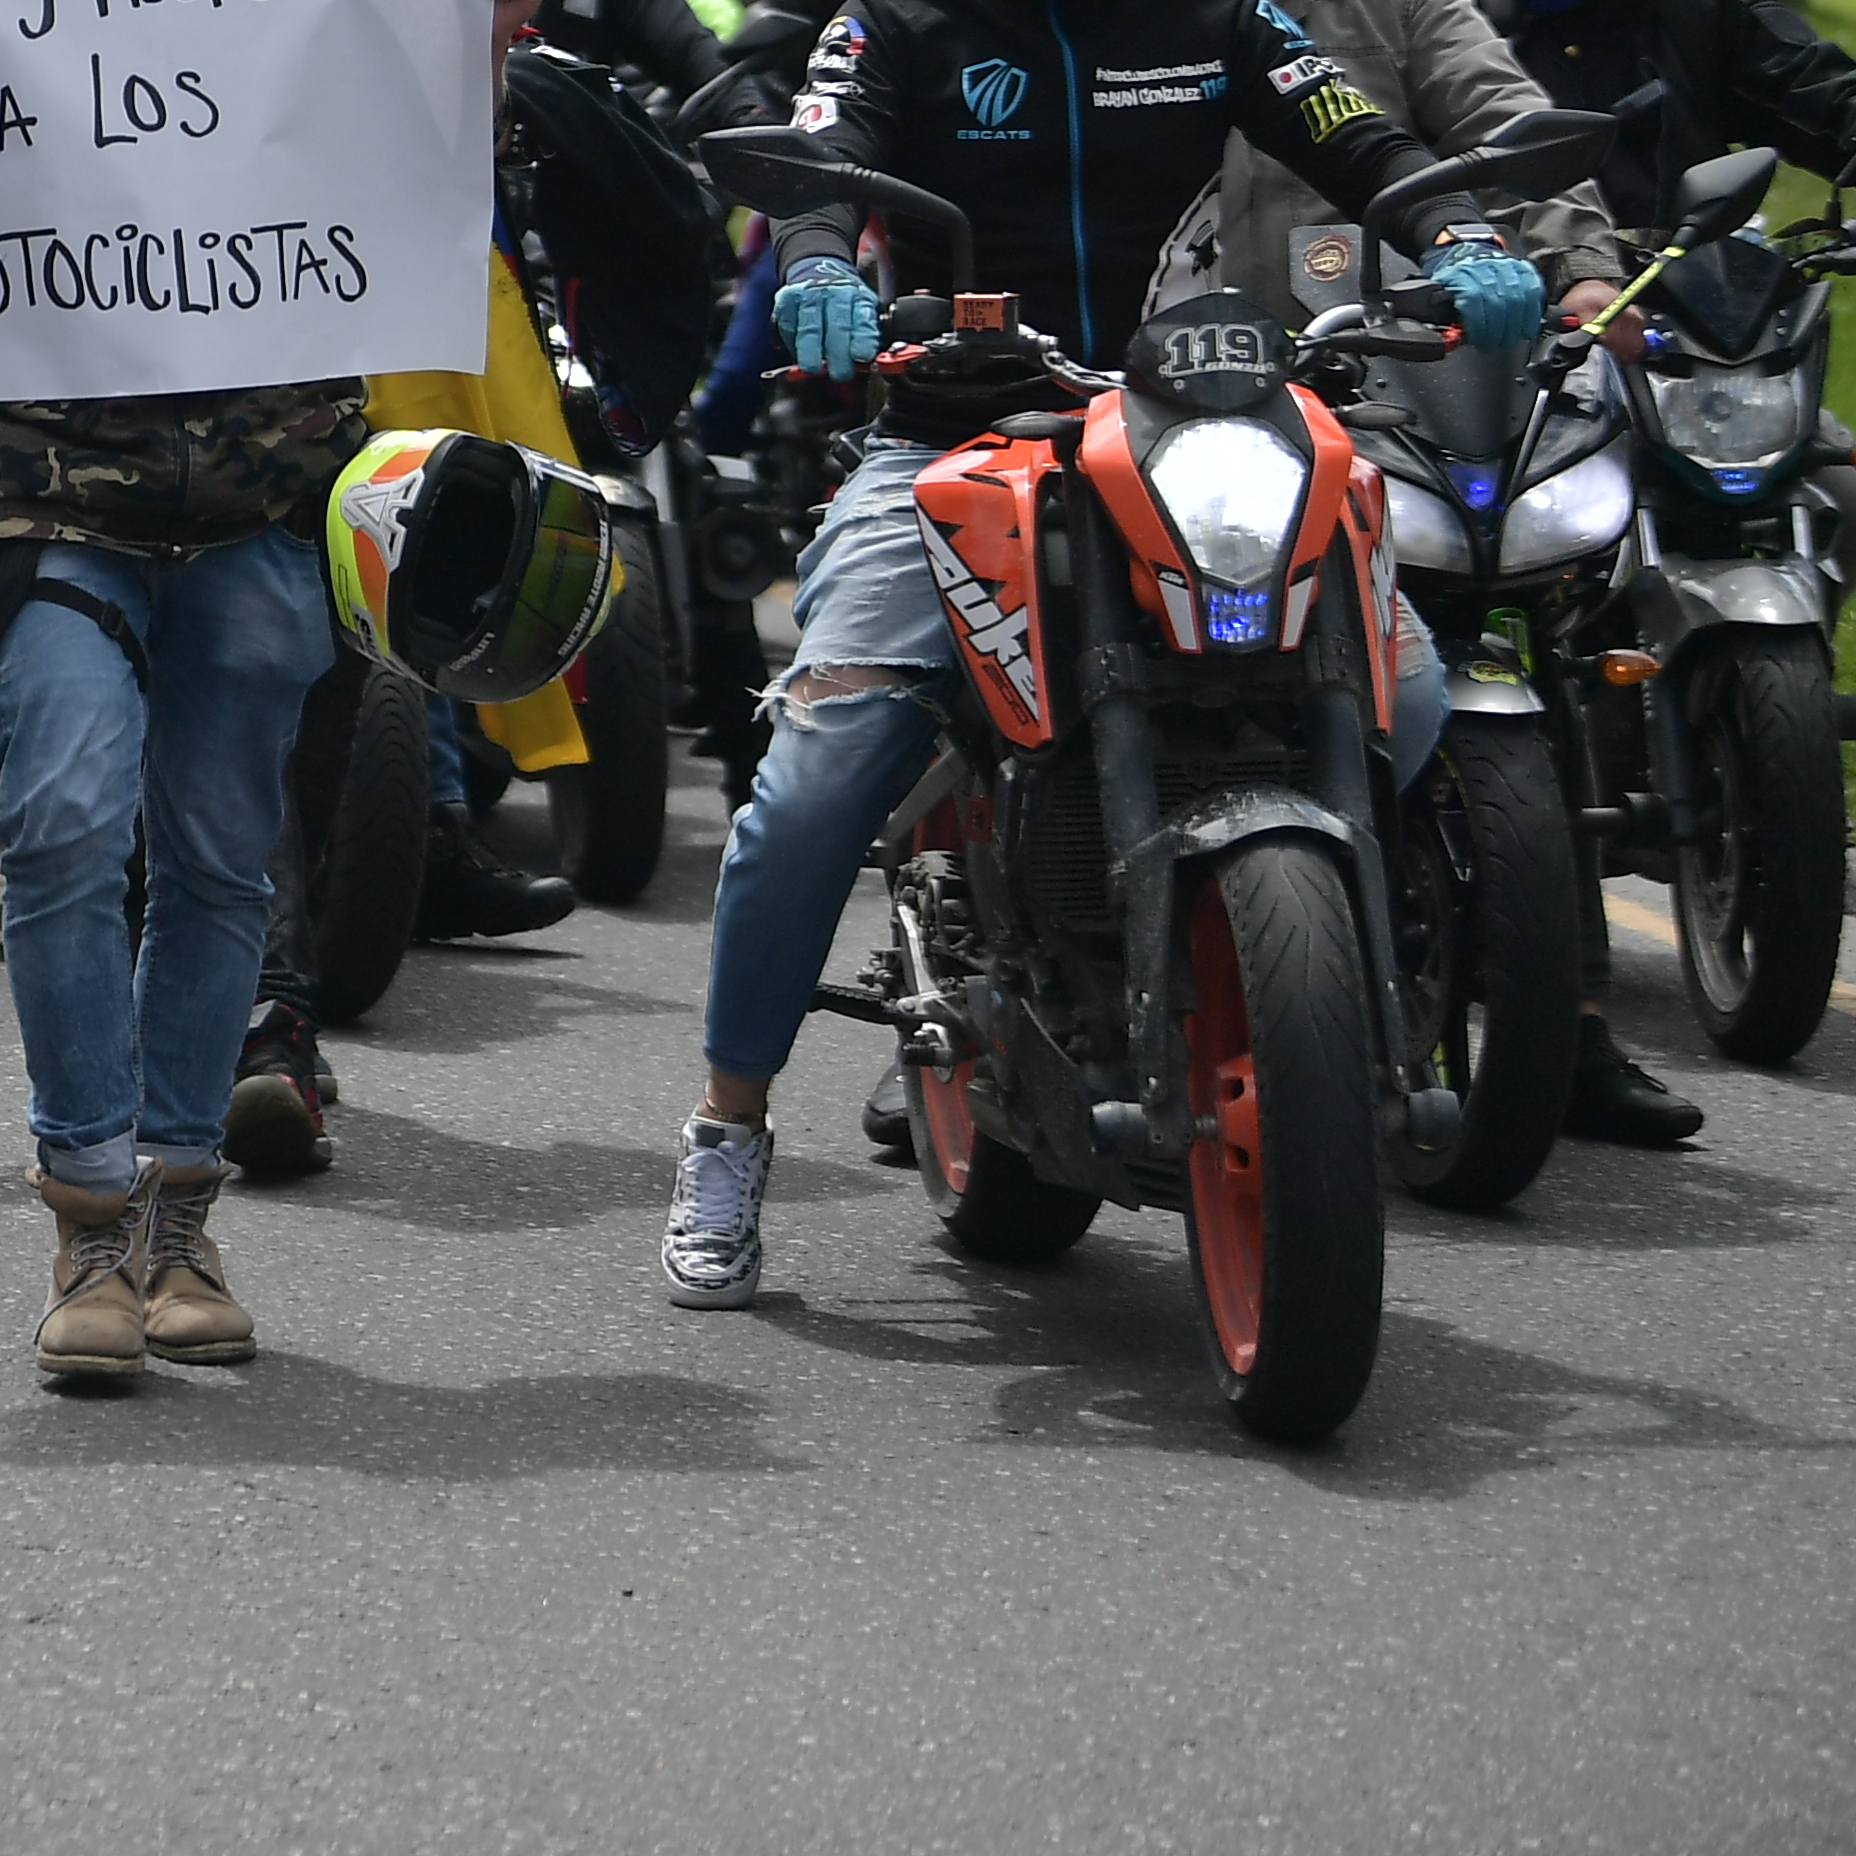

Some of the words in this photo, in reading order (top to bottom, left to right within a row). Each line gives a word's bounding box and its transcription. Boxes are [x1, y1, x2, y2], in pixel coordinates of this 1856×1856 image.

[91, 52, 219, 148] LOS
[1092, 87, 1138, 108] BRAYAN
[1138, 85, 1203, 106] GONZALEZ
[956, 129, 1032, 141] ESCATS
[1164, 323, 1265, 378] 119
